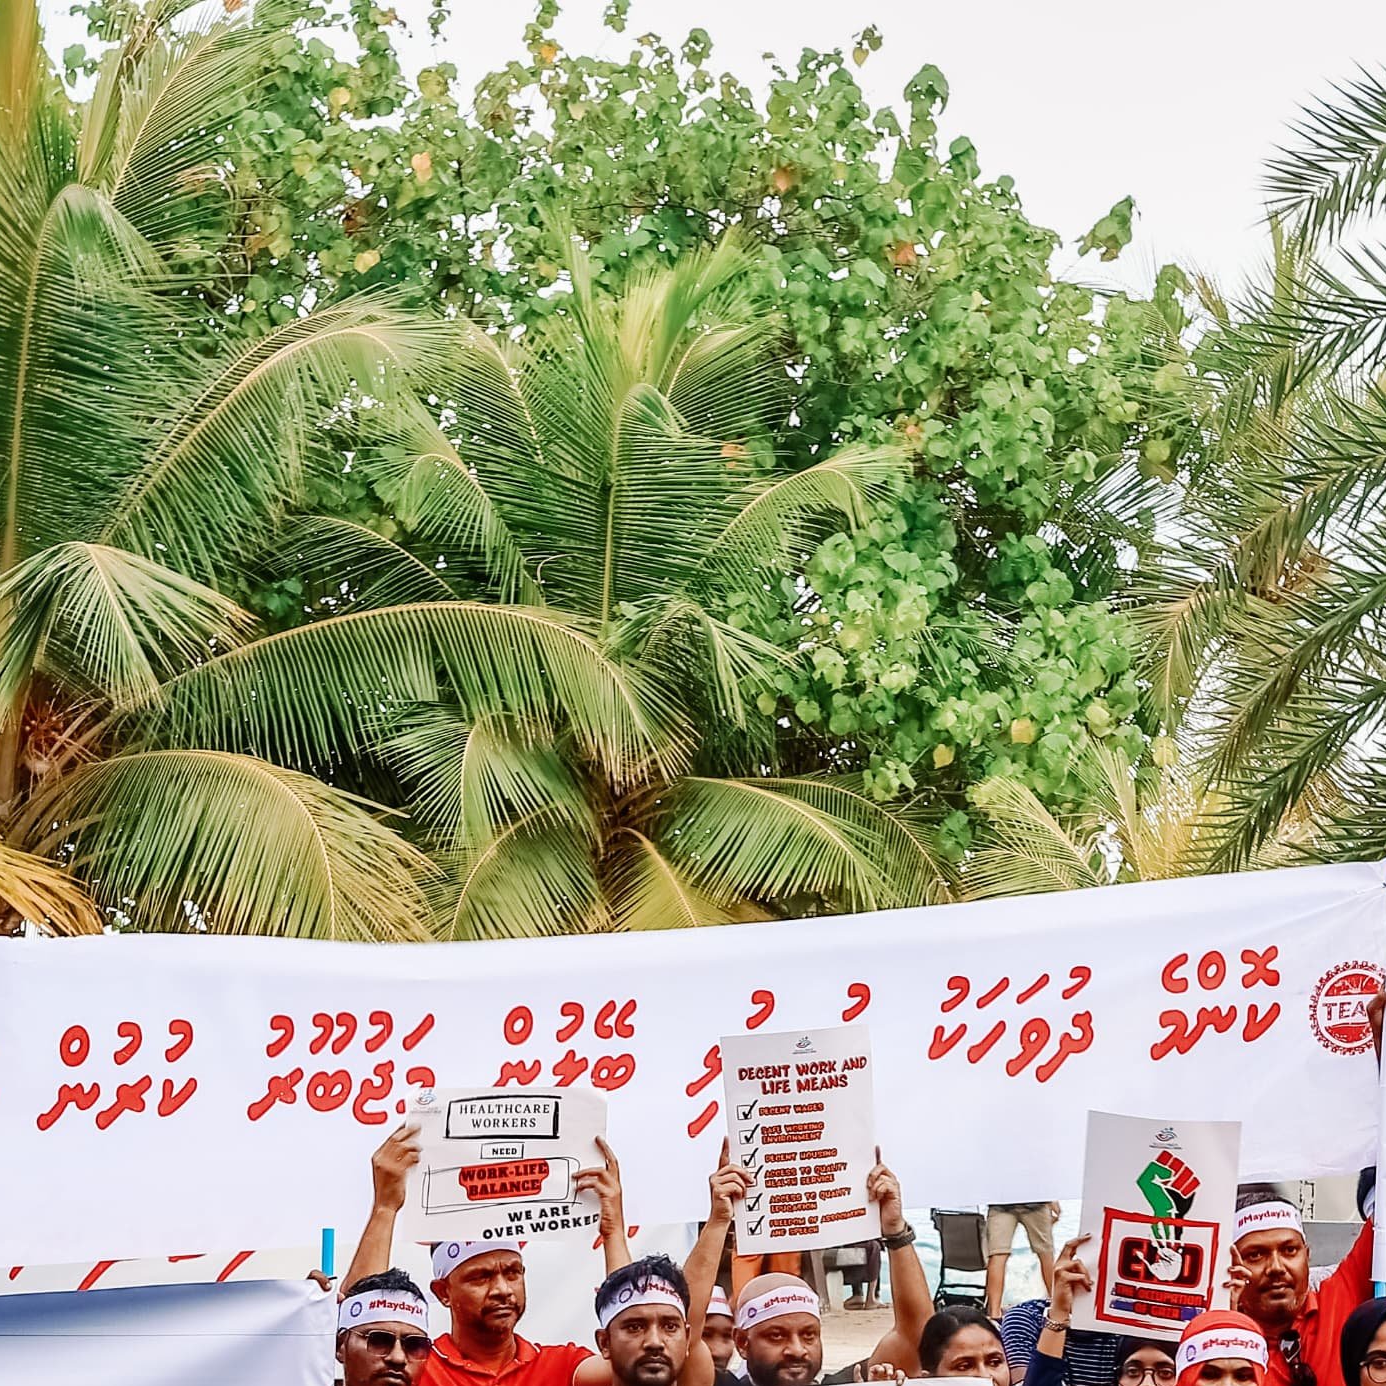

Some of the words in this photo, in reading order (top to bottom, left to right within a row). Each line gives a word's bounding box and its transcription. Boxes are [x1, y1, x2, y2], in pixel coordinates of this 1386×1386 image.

[1322, 1000, 1368, 1021] TEA
[738, 1063, 791, 1081] DECENT
[796, 1060, 837, 1076] WORK
[842, 1056, 868, 1071] AND
[761, 1079, 791, 1095] LIFE
[796, 1074, 848, 1093] MEANS
[460, 1103, 551, 1115] HEALTHCARE
[759, 1105, 791, 1116] DECENT
[794, 1102, 824, 1113] WAGES
[471, 1117, 537, 1129] WORKERS
[761, 1124, 782, 1135] SAFE
[785, 1121, 825, 1133] WORKING
[491, 1147, 518, 1155] NEED
[462, 1161, 548, 1181] WORK-LIFE
[469, 1179, 541, 1197] BALANCE
[508, 1210, 533, 1222] WE
[539, 1205, 571, 1219] ARE
[483, 1224, 526, 1240] OVER
[530, 1213, 600, 1234] WORKED
